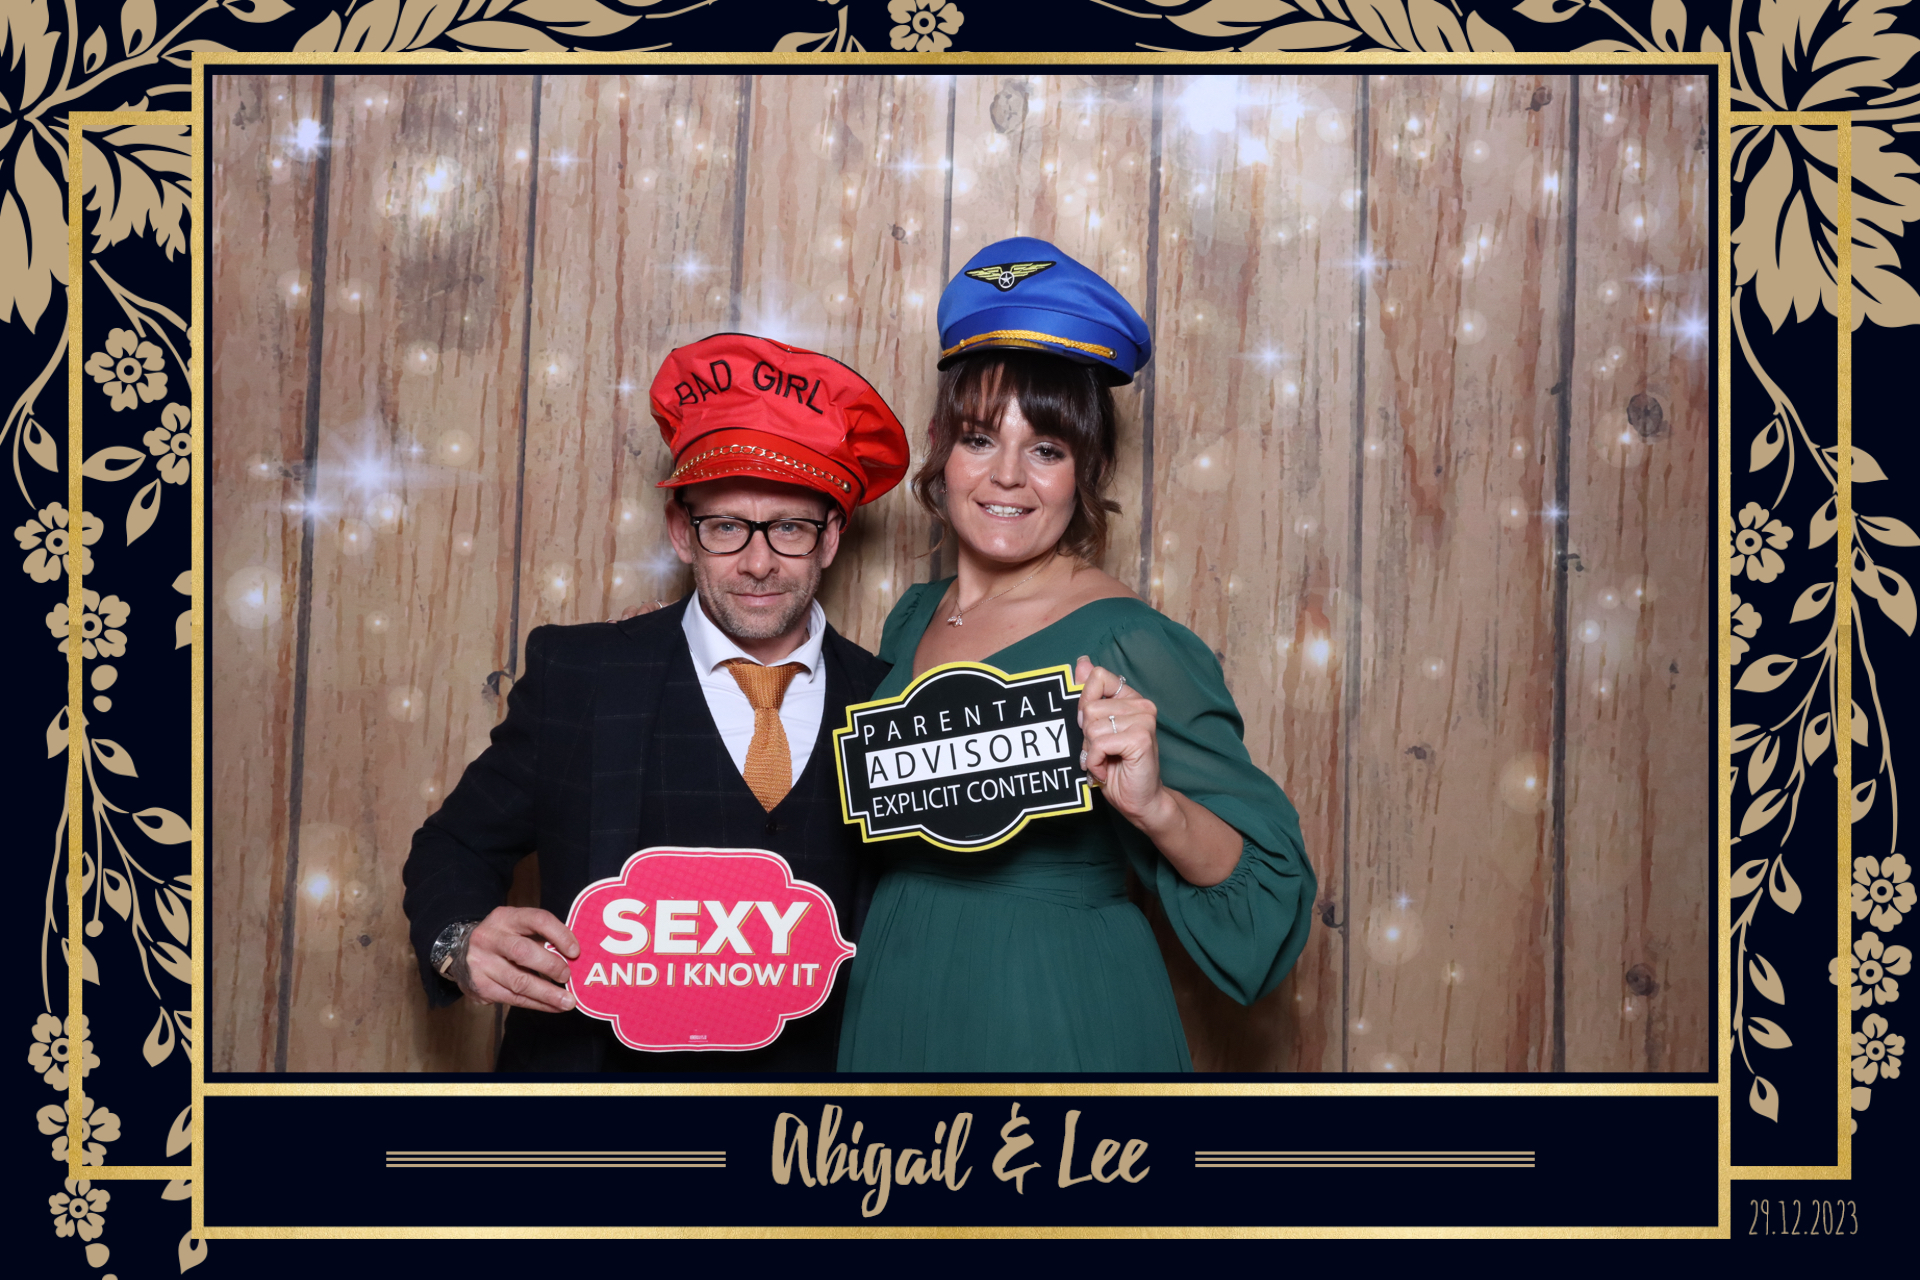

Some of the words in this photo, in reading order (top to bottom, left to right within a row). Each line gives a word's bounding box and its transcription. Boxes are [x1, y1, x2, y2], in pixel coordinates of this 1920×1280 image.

[674, 359, 732, 407] BAD
[752, 360, 824, 415] GIRL
[863, 691, 1062, 745] PARENTAL
[869, 723, 1065, 784] ADVISORY
[872, 784, 961, 818] EXPLICIT
[966, 766, 1073, 803] CONTENT
[599, 898, 813, 956] SEXY
[583, 962, 659, 987] AND
[666, 962, 675, 987] I
[683, 963, 787, 987] KNOW
[792, 963, 821, 987] IT
